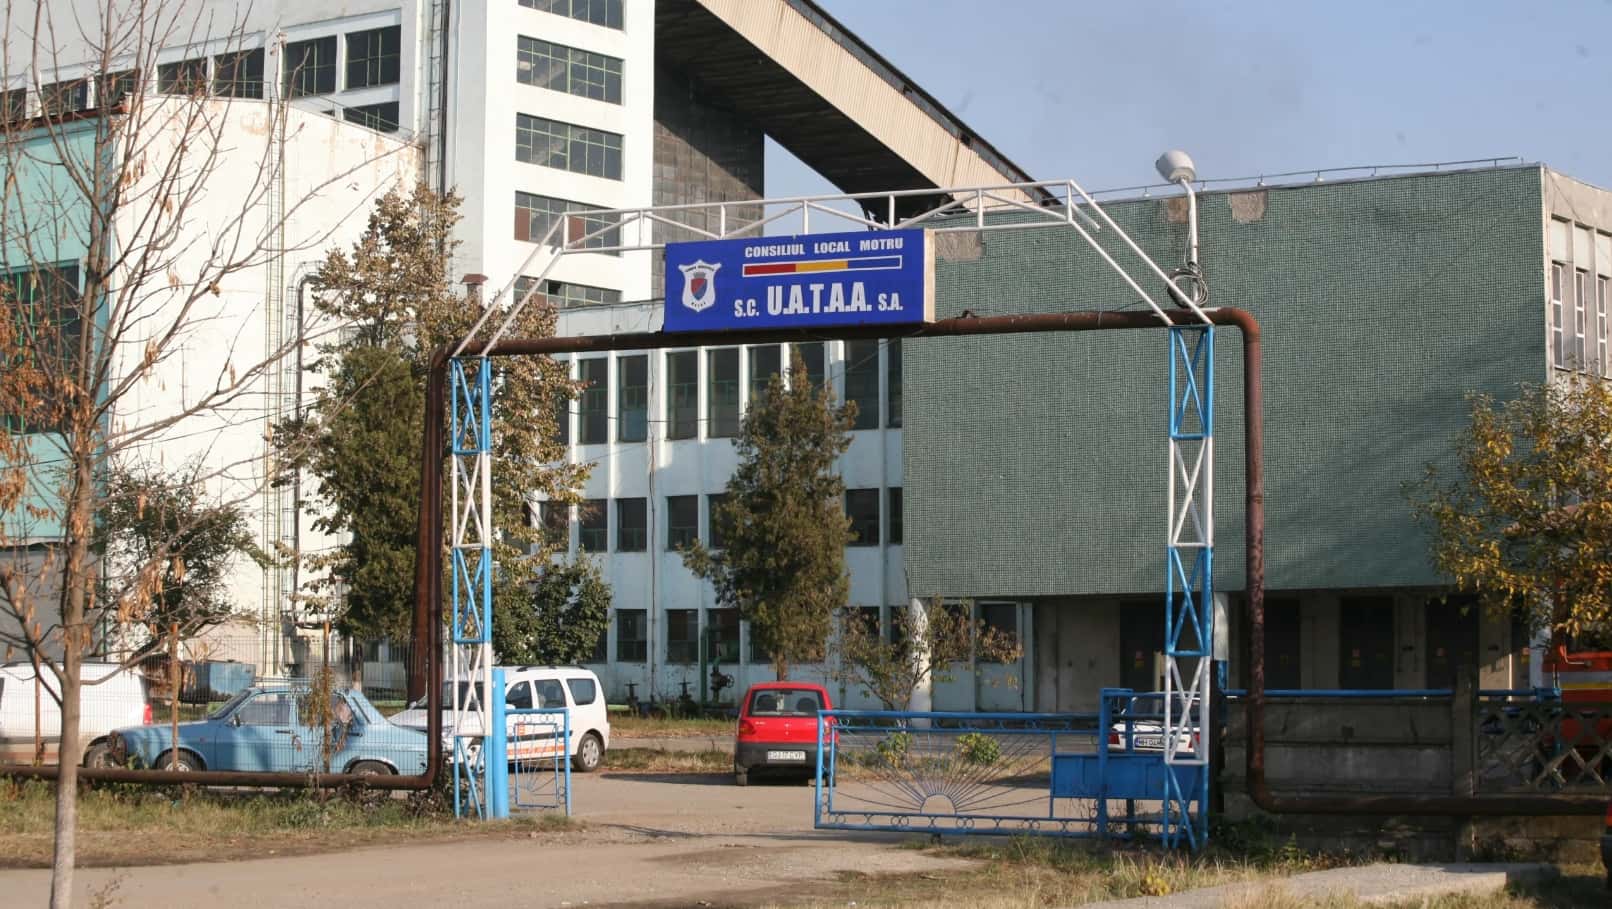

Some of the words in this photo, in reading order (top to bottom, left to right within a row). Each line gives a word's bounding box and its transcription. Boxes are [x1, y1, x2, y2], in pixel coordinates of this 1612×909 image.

[744, 243, 806, 258] CONSILIUL
[814, 240, 851, 254] LOCAL
[859, 237, 904, 251] MOTRU
[734, 299, 760, 318] S.C.
[767, 281, 872, 316] U.A.T.A.A.
[878, 293, 904, 312] S.A.
